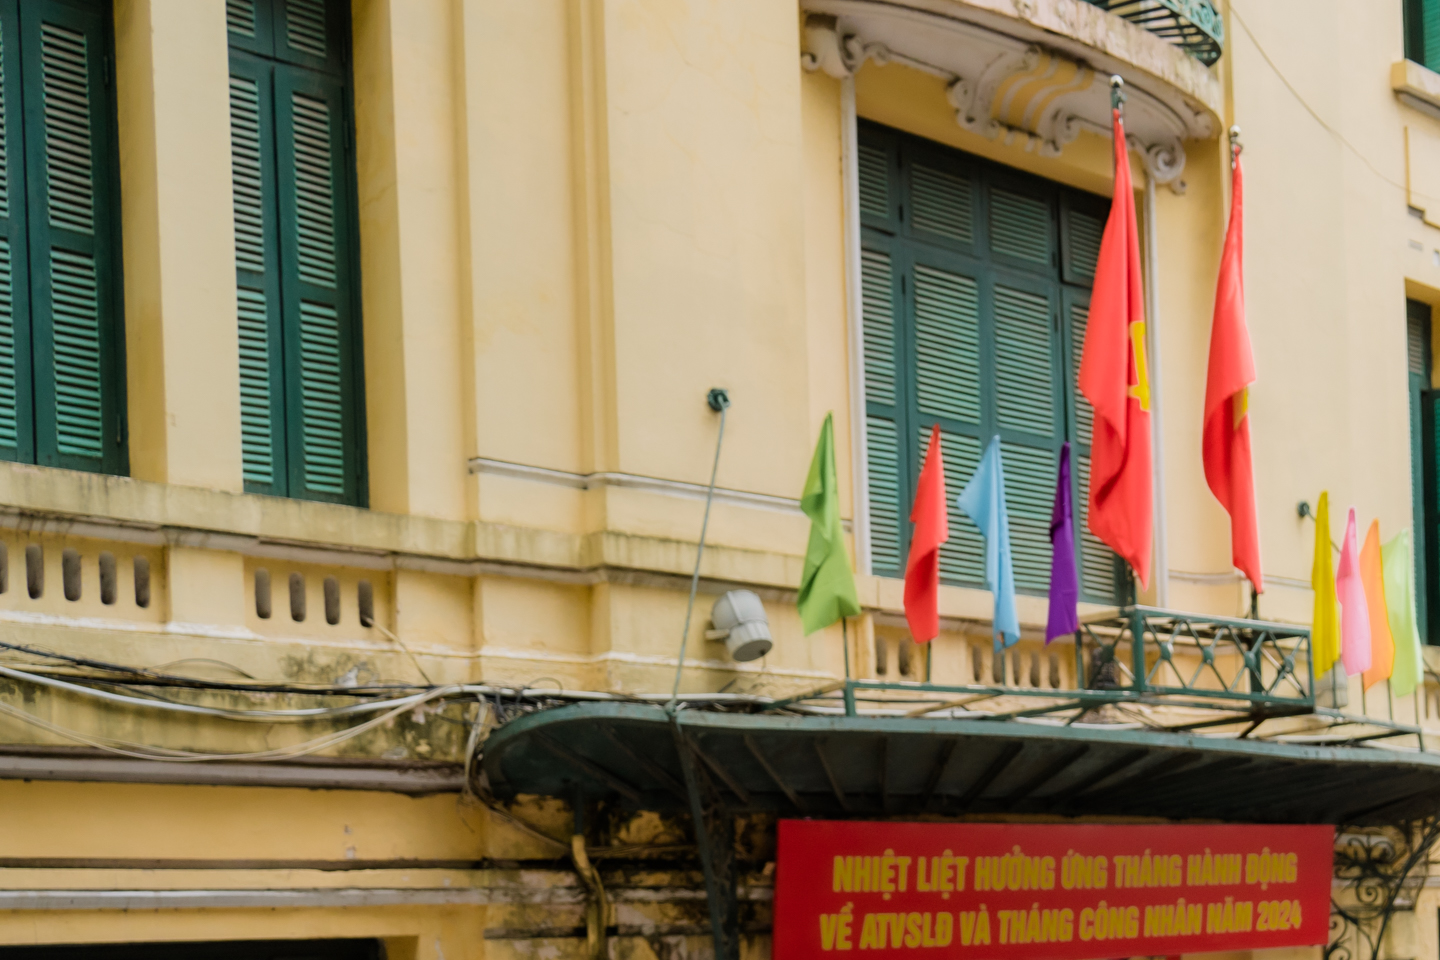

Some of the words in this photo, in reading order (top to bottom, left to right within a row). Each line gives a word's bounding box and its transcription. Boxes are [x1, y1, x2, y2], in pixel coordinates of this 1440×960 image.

[832, 848, 911, 901] NHIỆT
[917, 848, 969, 900] LIỆT
[974, 845, 1055, 893] HƯỞNG
[1061, 848, 1108, 890] ỨNG
[1114, 848, 1183, 889] THÁNG
[1186, 847, 1242, 887] HÀNH
[1245, 847, 1298, 891] ĐỘNG
[820, 901, 853, 951] VỀ
[859, 910, 953, 949] ATVSLĐ
[960, 904, 991, 946] VÀ
[998, 901, 1073, 944] THÁNG
[1078, 898, 1139, 942] CÔNG
[1144, 898, 1203, 938] NHÂN
[1206, 896, 1253, 934] NĂM
[1256, 899, 1302, 932] 2024
